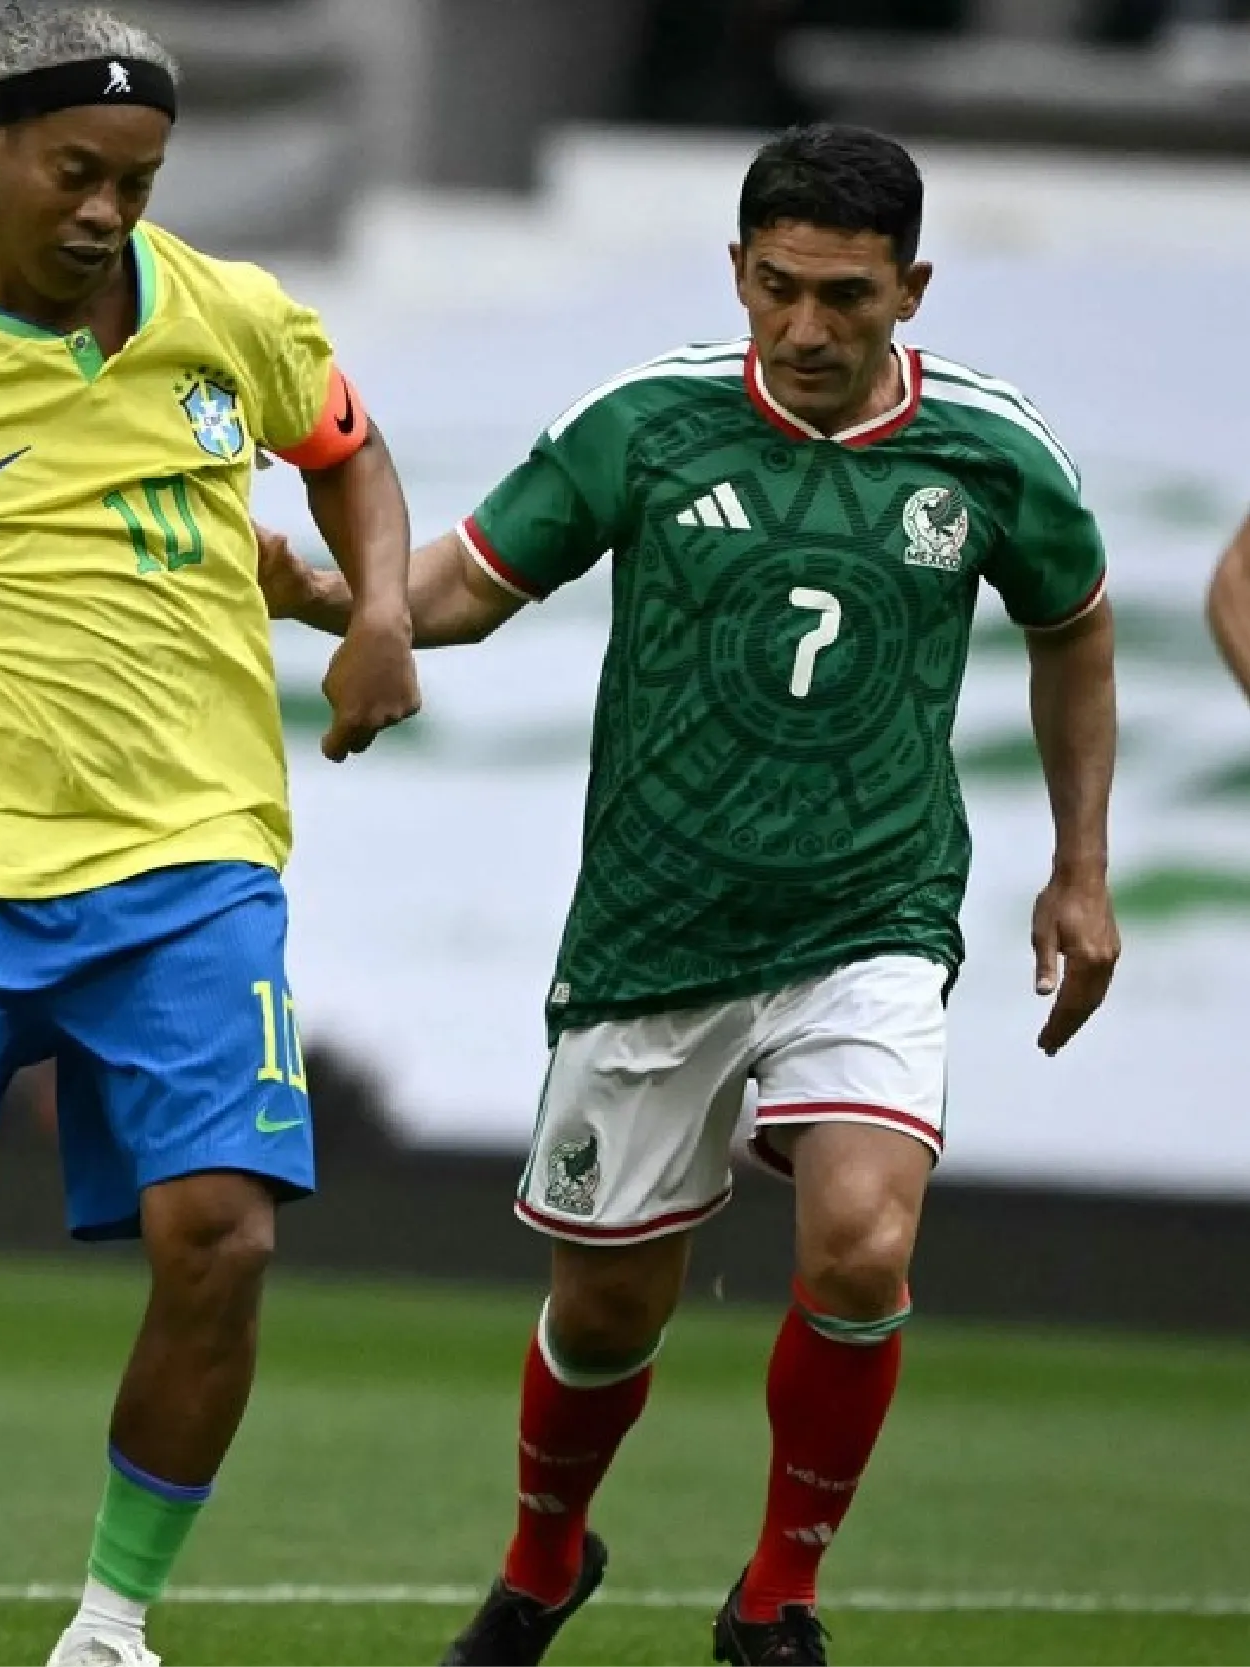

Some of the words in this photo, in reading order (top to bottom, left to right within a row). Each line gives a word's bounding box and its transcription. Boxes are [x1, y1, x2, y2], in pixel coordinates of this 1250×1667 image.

[102, 475, 204, 575] 10
[789, 587, 841, 698] 7
[253, 981, 307, 1094] 10
